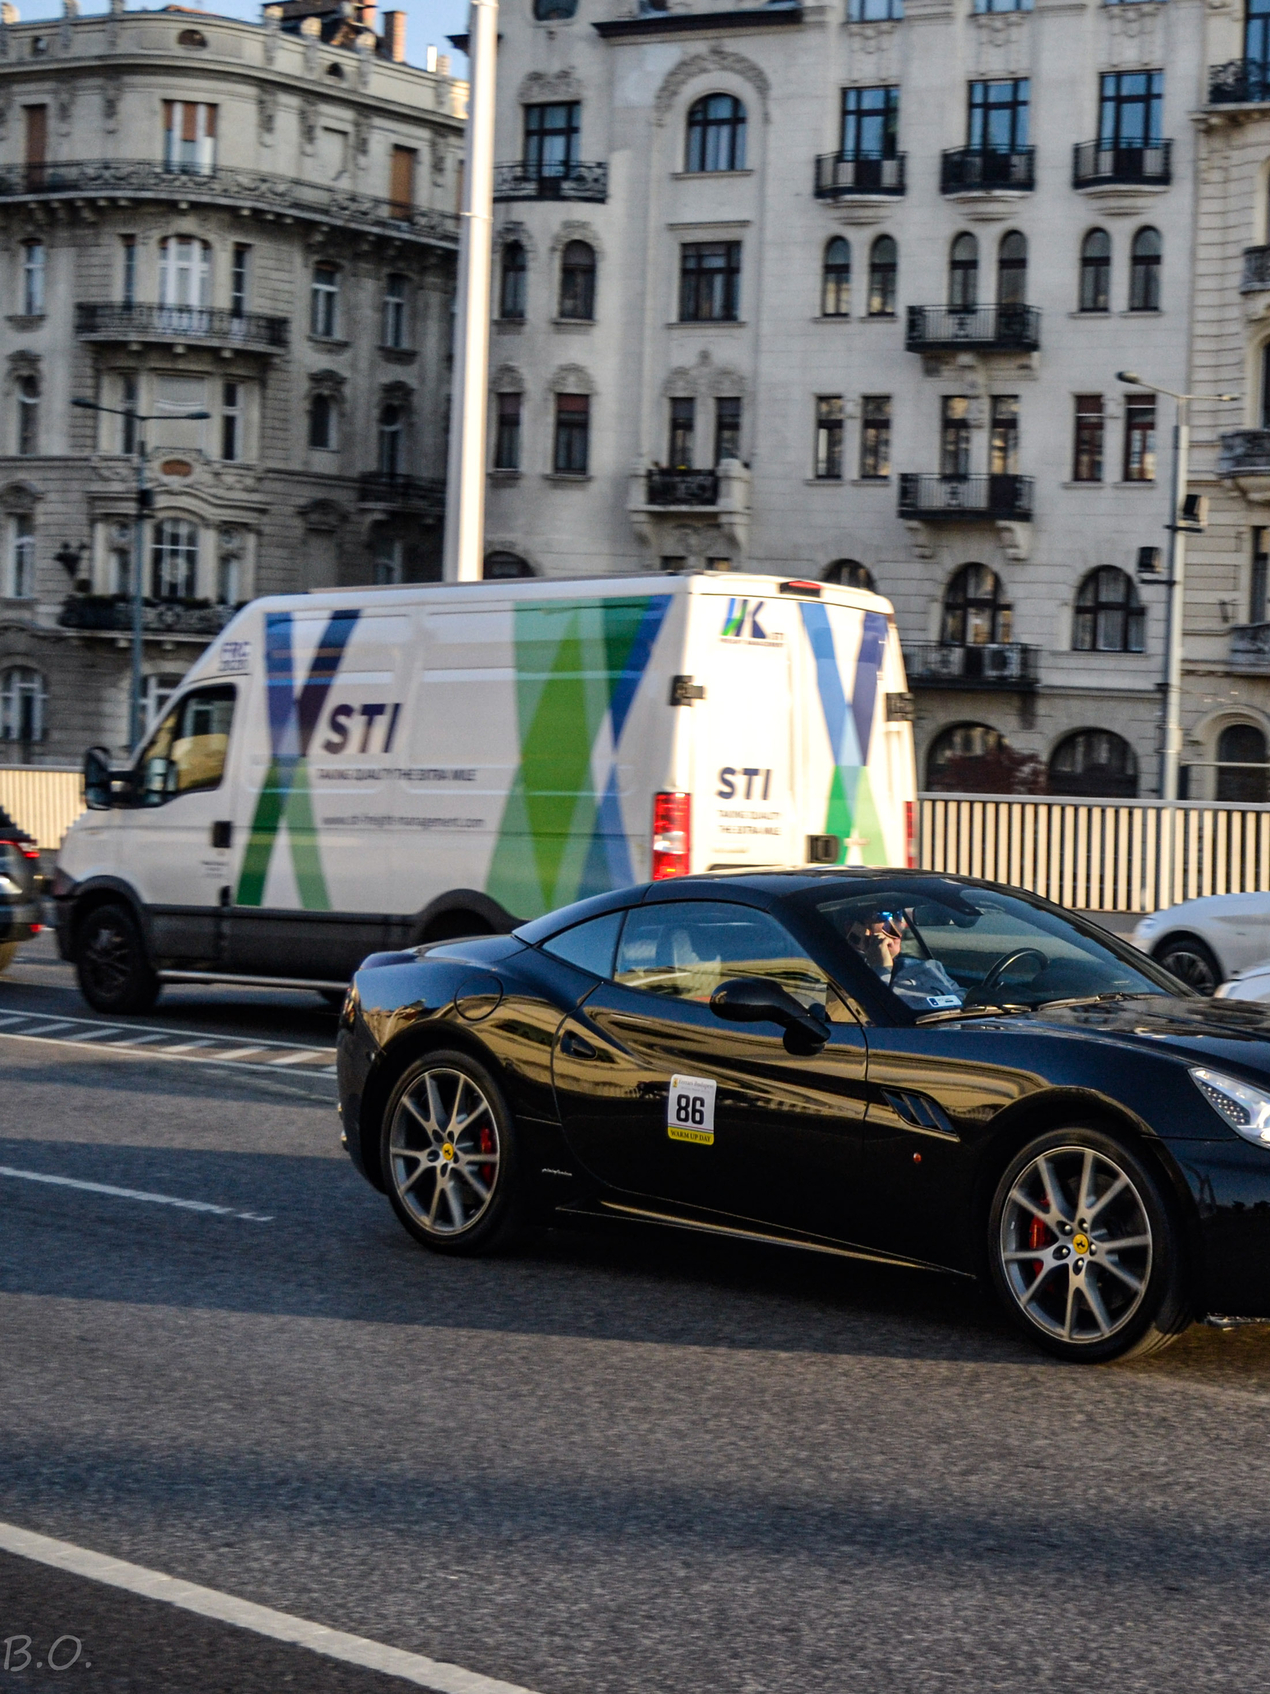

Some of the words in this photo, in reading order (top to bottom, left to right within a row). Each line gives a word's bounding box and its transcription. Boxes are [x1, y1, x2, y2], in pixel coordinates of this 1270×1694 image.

[322, 702, 402, 754] STI
[317, 768, 351, 780] TAKING
[353, 769, 395, 782] QUALITY
[416, 769, 447, 782] EXTRA
[448, 769, 478, 782] MILE
[715, 766, 772, 801] STI
[676, 1093, 706, 1125] 86
[670, 1130, 690, 1139] WARM
[699, 1134, 712, 1142] DAY
